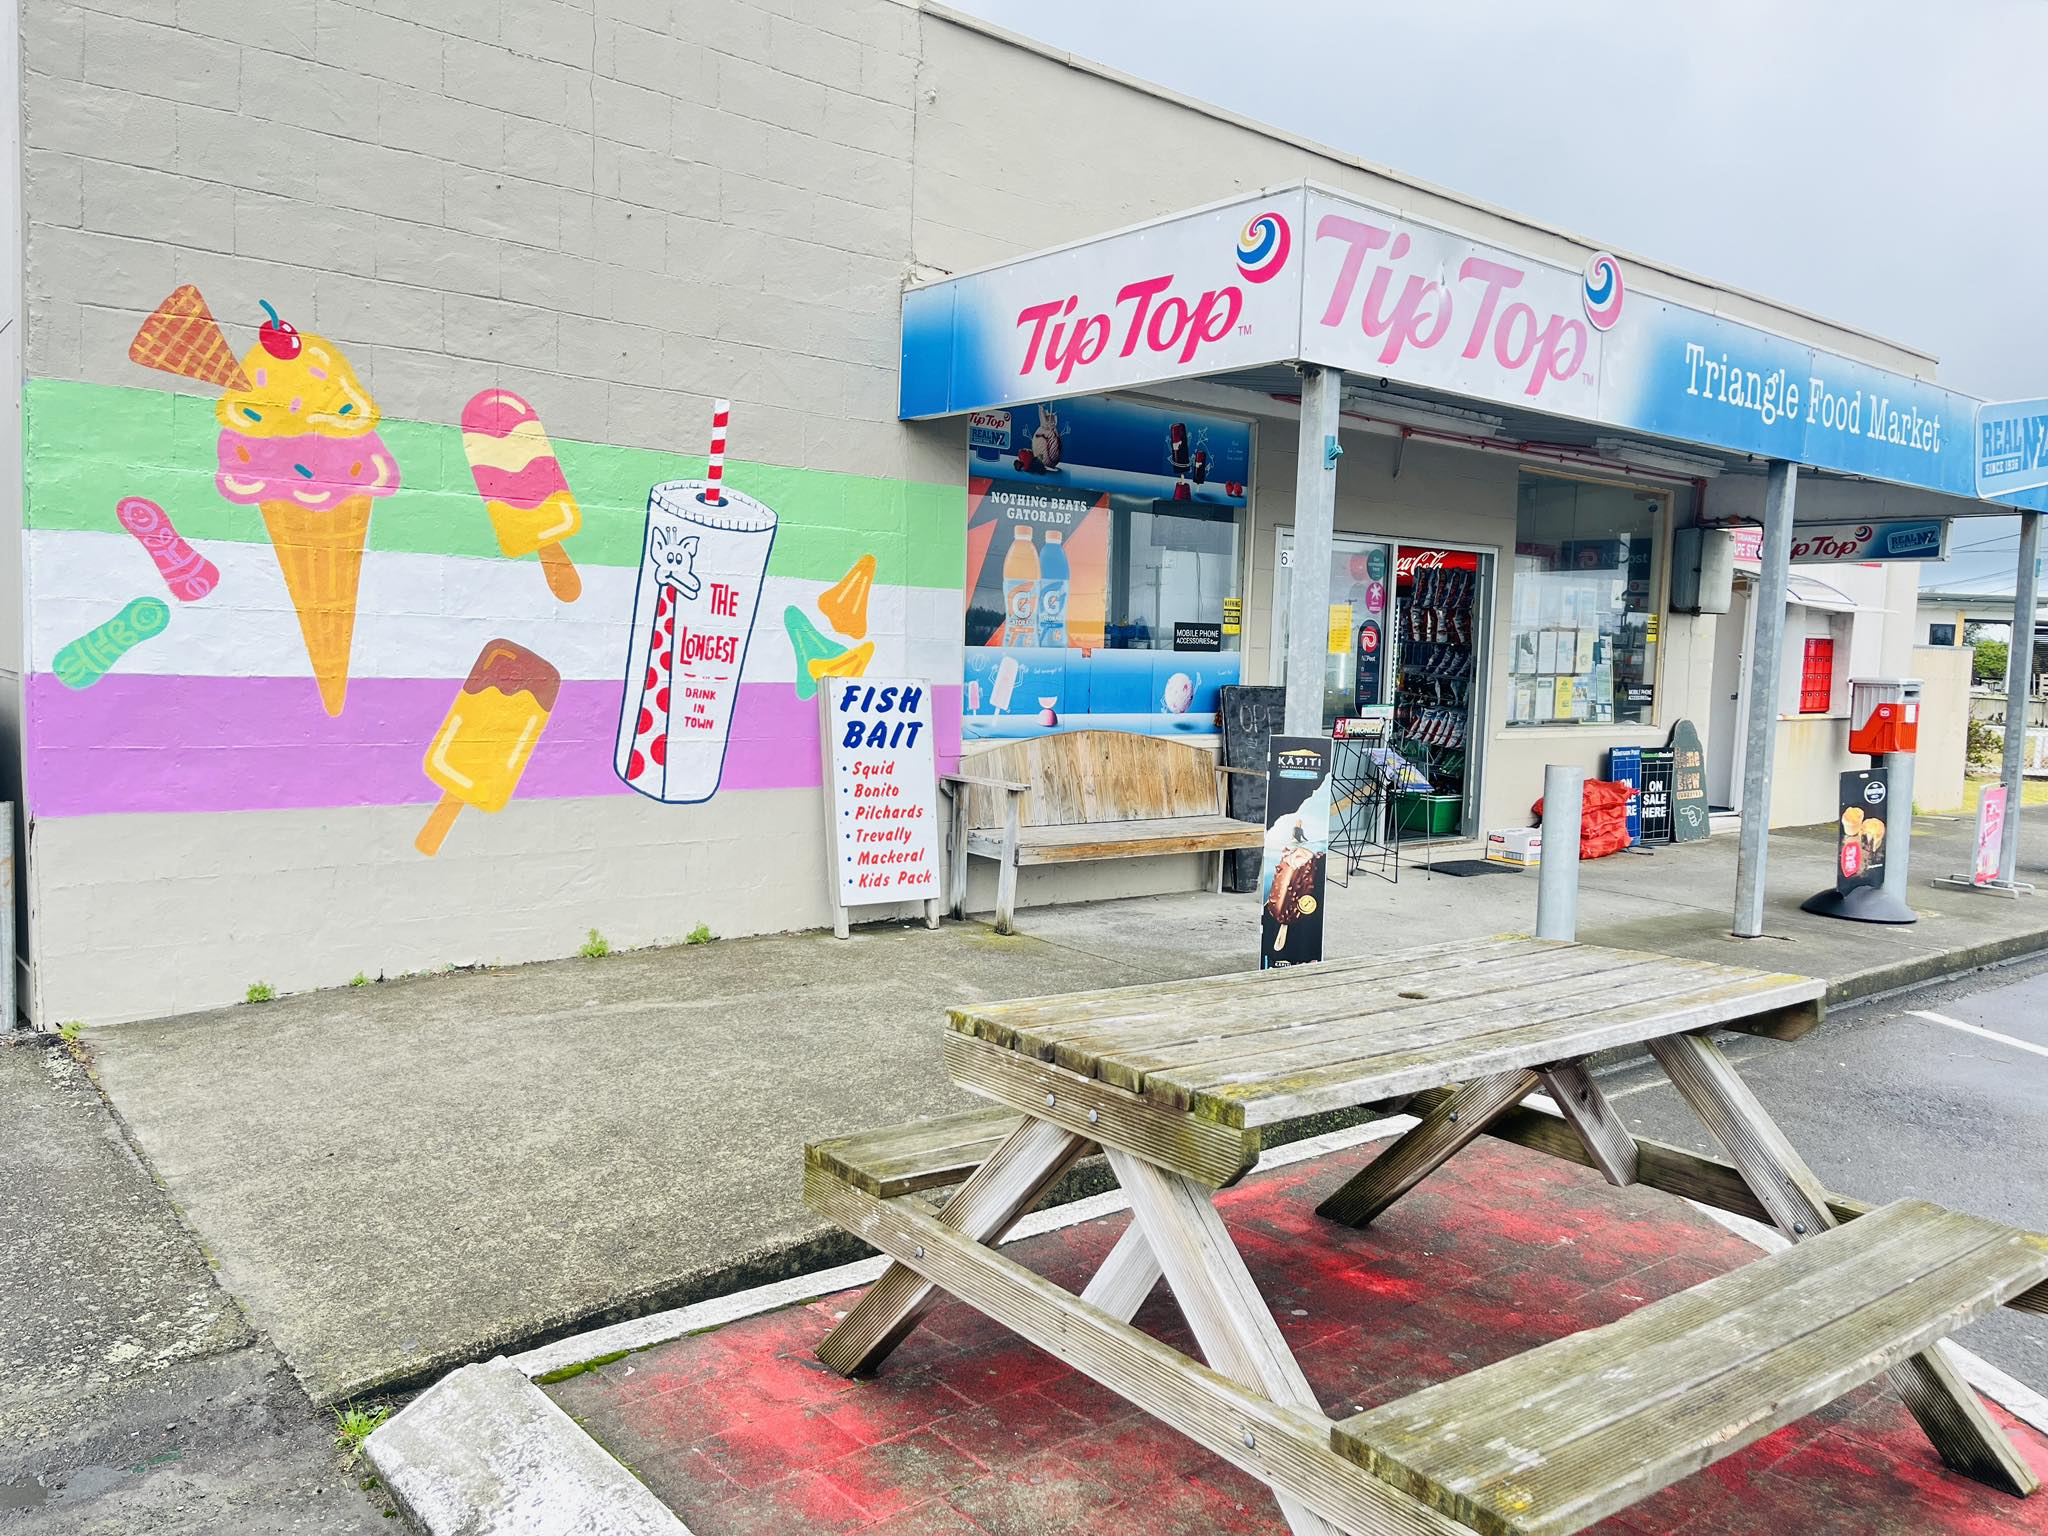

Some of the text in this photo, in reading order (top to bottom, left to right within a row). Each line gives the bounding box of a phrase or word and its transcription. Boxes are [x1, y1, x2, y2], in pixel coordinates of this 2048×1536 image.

[1316, 214, 1453, 365] Tip
[1458, 257, 1588, 396] Top
[1017, 294, 1111, 384] Tip
[1115, 274, 1243, 364] Top
[1685, 342, 1941, 454] Triangle Food Market
[969, 412, 1005, 429] Tip Top
[1982, 418, 2021, 458] REAL
[1985, 461, 2004, 475] SINCE
[991, 491, 1088, 512] NOTHING BEATS
[1006, 507, 1072, 524] GATORADE
[1812, 536, 1857, 559] Top
[710, 583, 739, 617] THE
[1176, 629, 1219, 638] MOBILE PHONE
[680, 626, 739, 665] LONGEST
[685, 688, 717, 700] DRINK
[840, 685, 923, 714] FISH
[693, 703, 705, 714] IN
[684, 716, 714, 730] TOWN
[842, 720, 924, 749] BAIT
[852, 761, 895, 780] Squid
[854, 782, 900, 798] Bonito
[1649, 781, 1663, 792] ON
[1643, 793, 1666, 805] SALE
[855, 804, 924, 821] Pilchards
[1642, 807, 1666, 818] HERE
[856, 826, 912, 845] Trevally
[857, 848, 925, 866] Mackeral
[859, 869, 932, 888] Kids Pack
